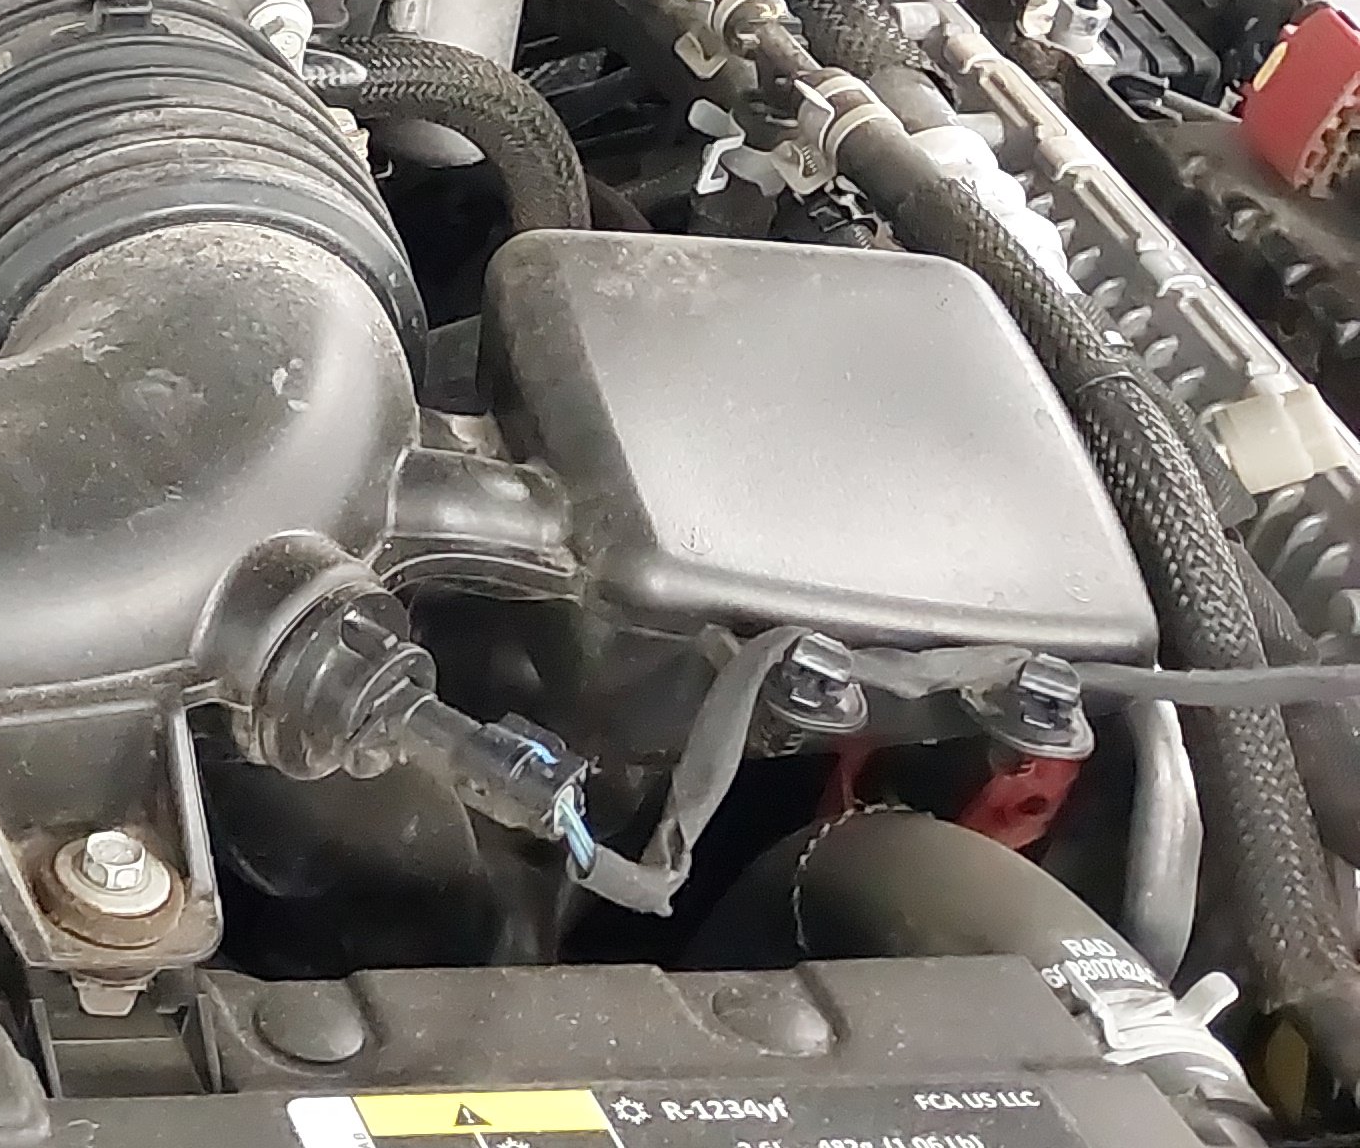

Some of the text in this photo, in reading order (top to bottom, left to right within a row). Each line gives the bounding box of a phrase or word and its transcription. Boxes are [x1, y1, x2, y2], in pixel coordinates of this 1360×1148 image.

[1061, 938, 1118, 958] RAD
[661, 1097, 790, 1124] R-1234yf
[913, 1089, 1042, 1112] FCA US LLC
